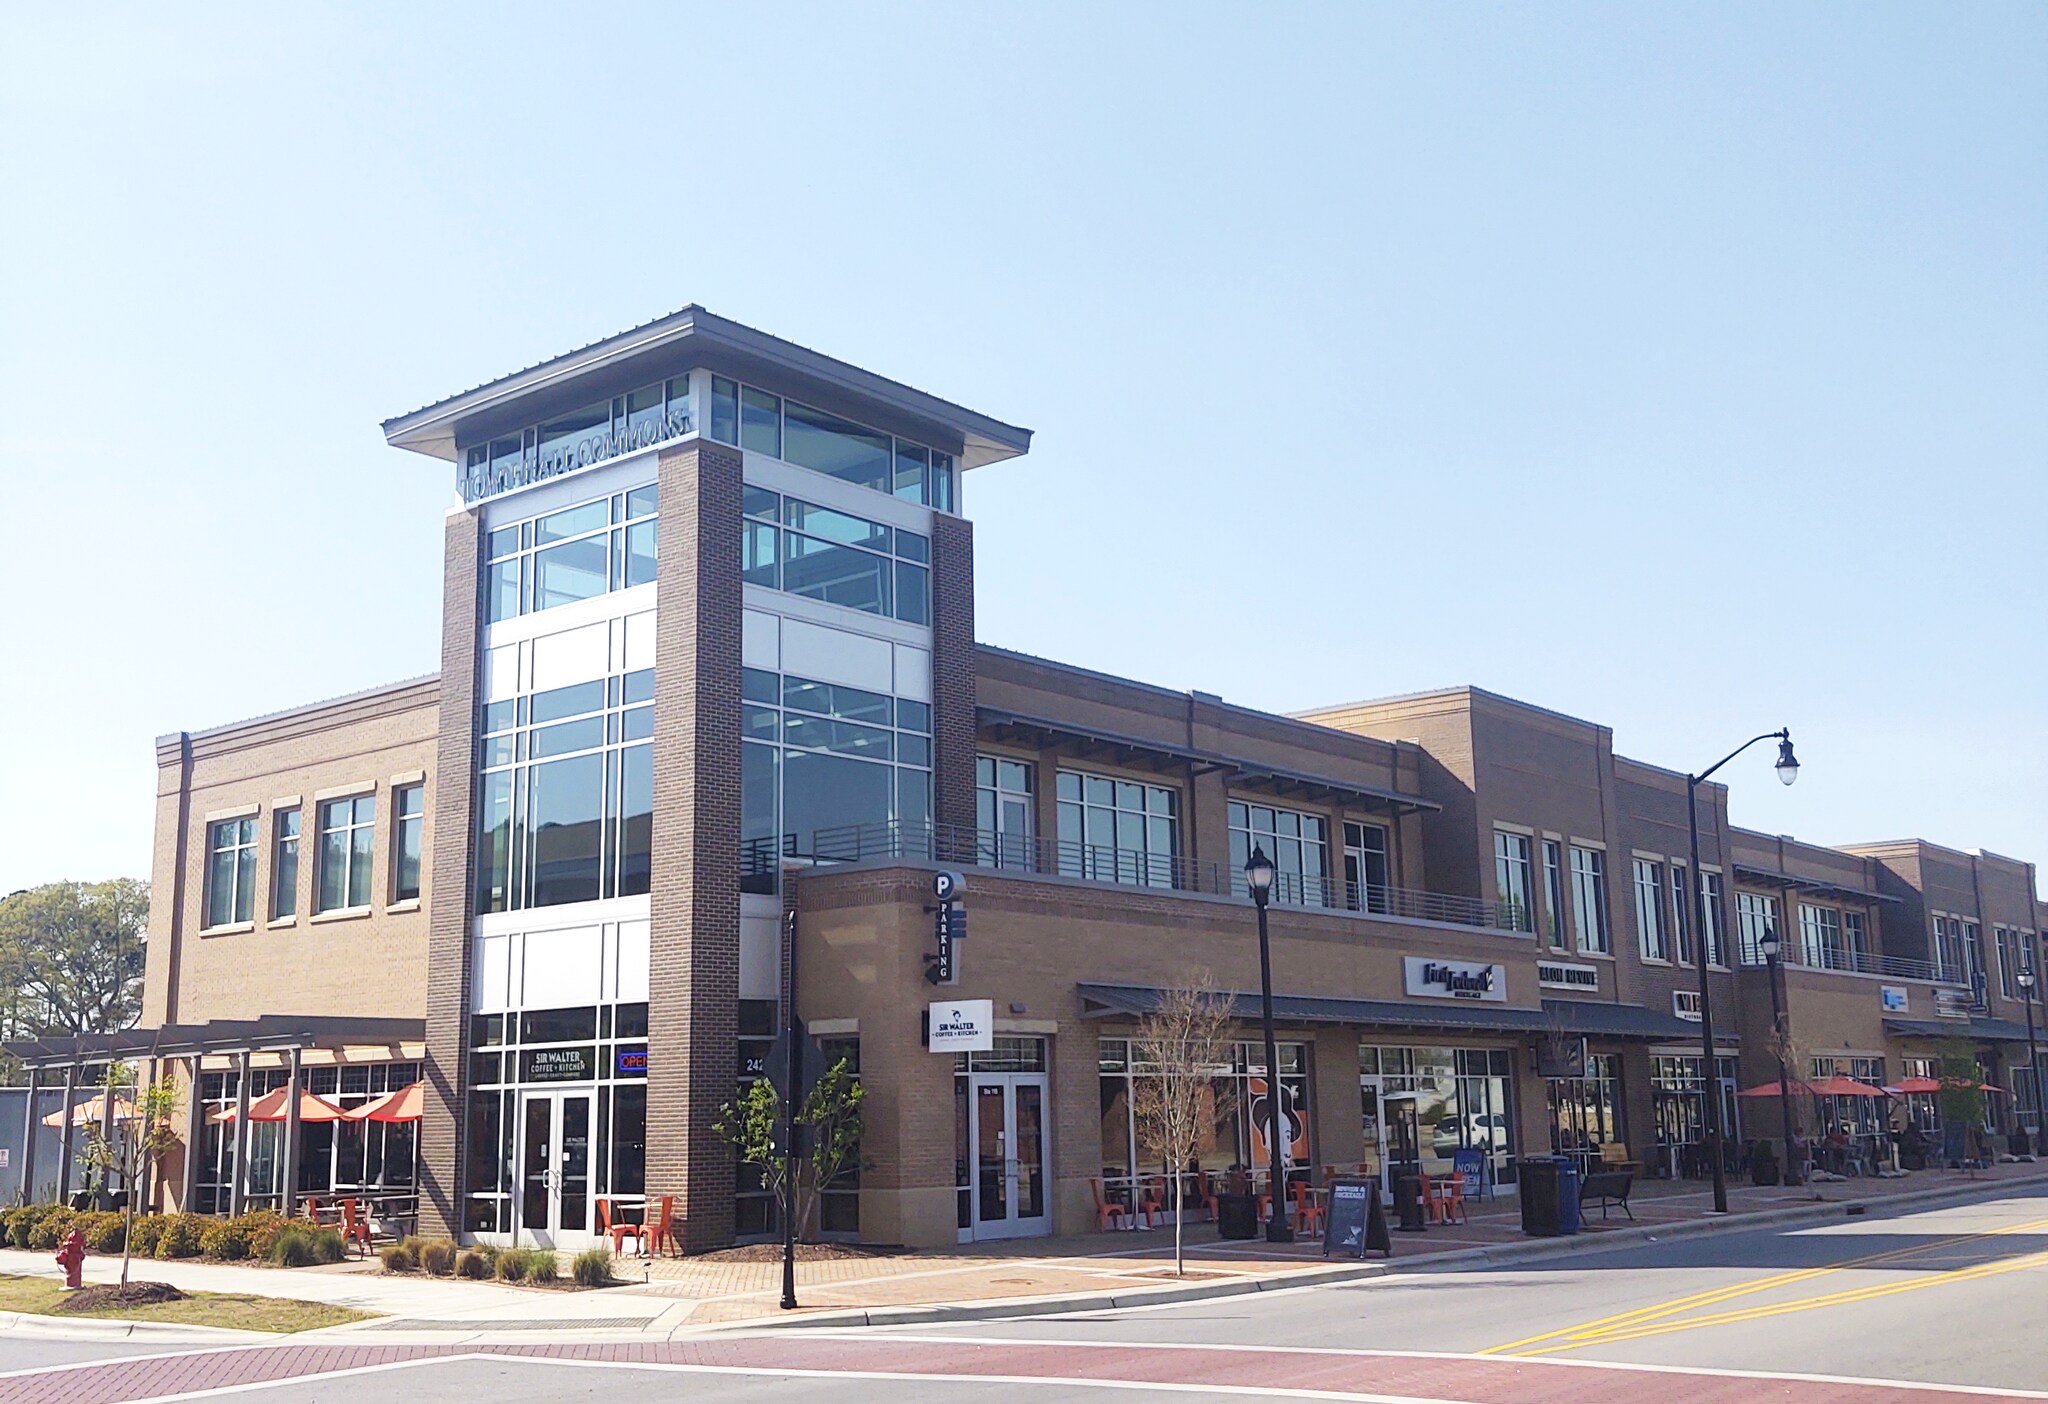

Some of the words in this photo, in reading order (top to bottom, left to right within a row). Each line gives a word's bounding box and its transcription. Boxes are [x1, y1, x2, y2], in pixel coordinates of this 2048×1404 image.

[578, 409, 688, 464] COMMONS
[937, 876, 949, 895] P
[940, 903, 948, 977] PARKING
[939, 1023, 949, 1031] SIR
[949, 1022, 974, 1030] WALTER
[536, 1054, 548, 1064] SIR
[549, 1051, 580, 1062] WALTER
[531, 1063, 553, 1073] COFFEE
[559, 1062, 585, 1071] KITCHEN
[1457, 1163, 1480, 1173] NOW
